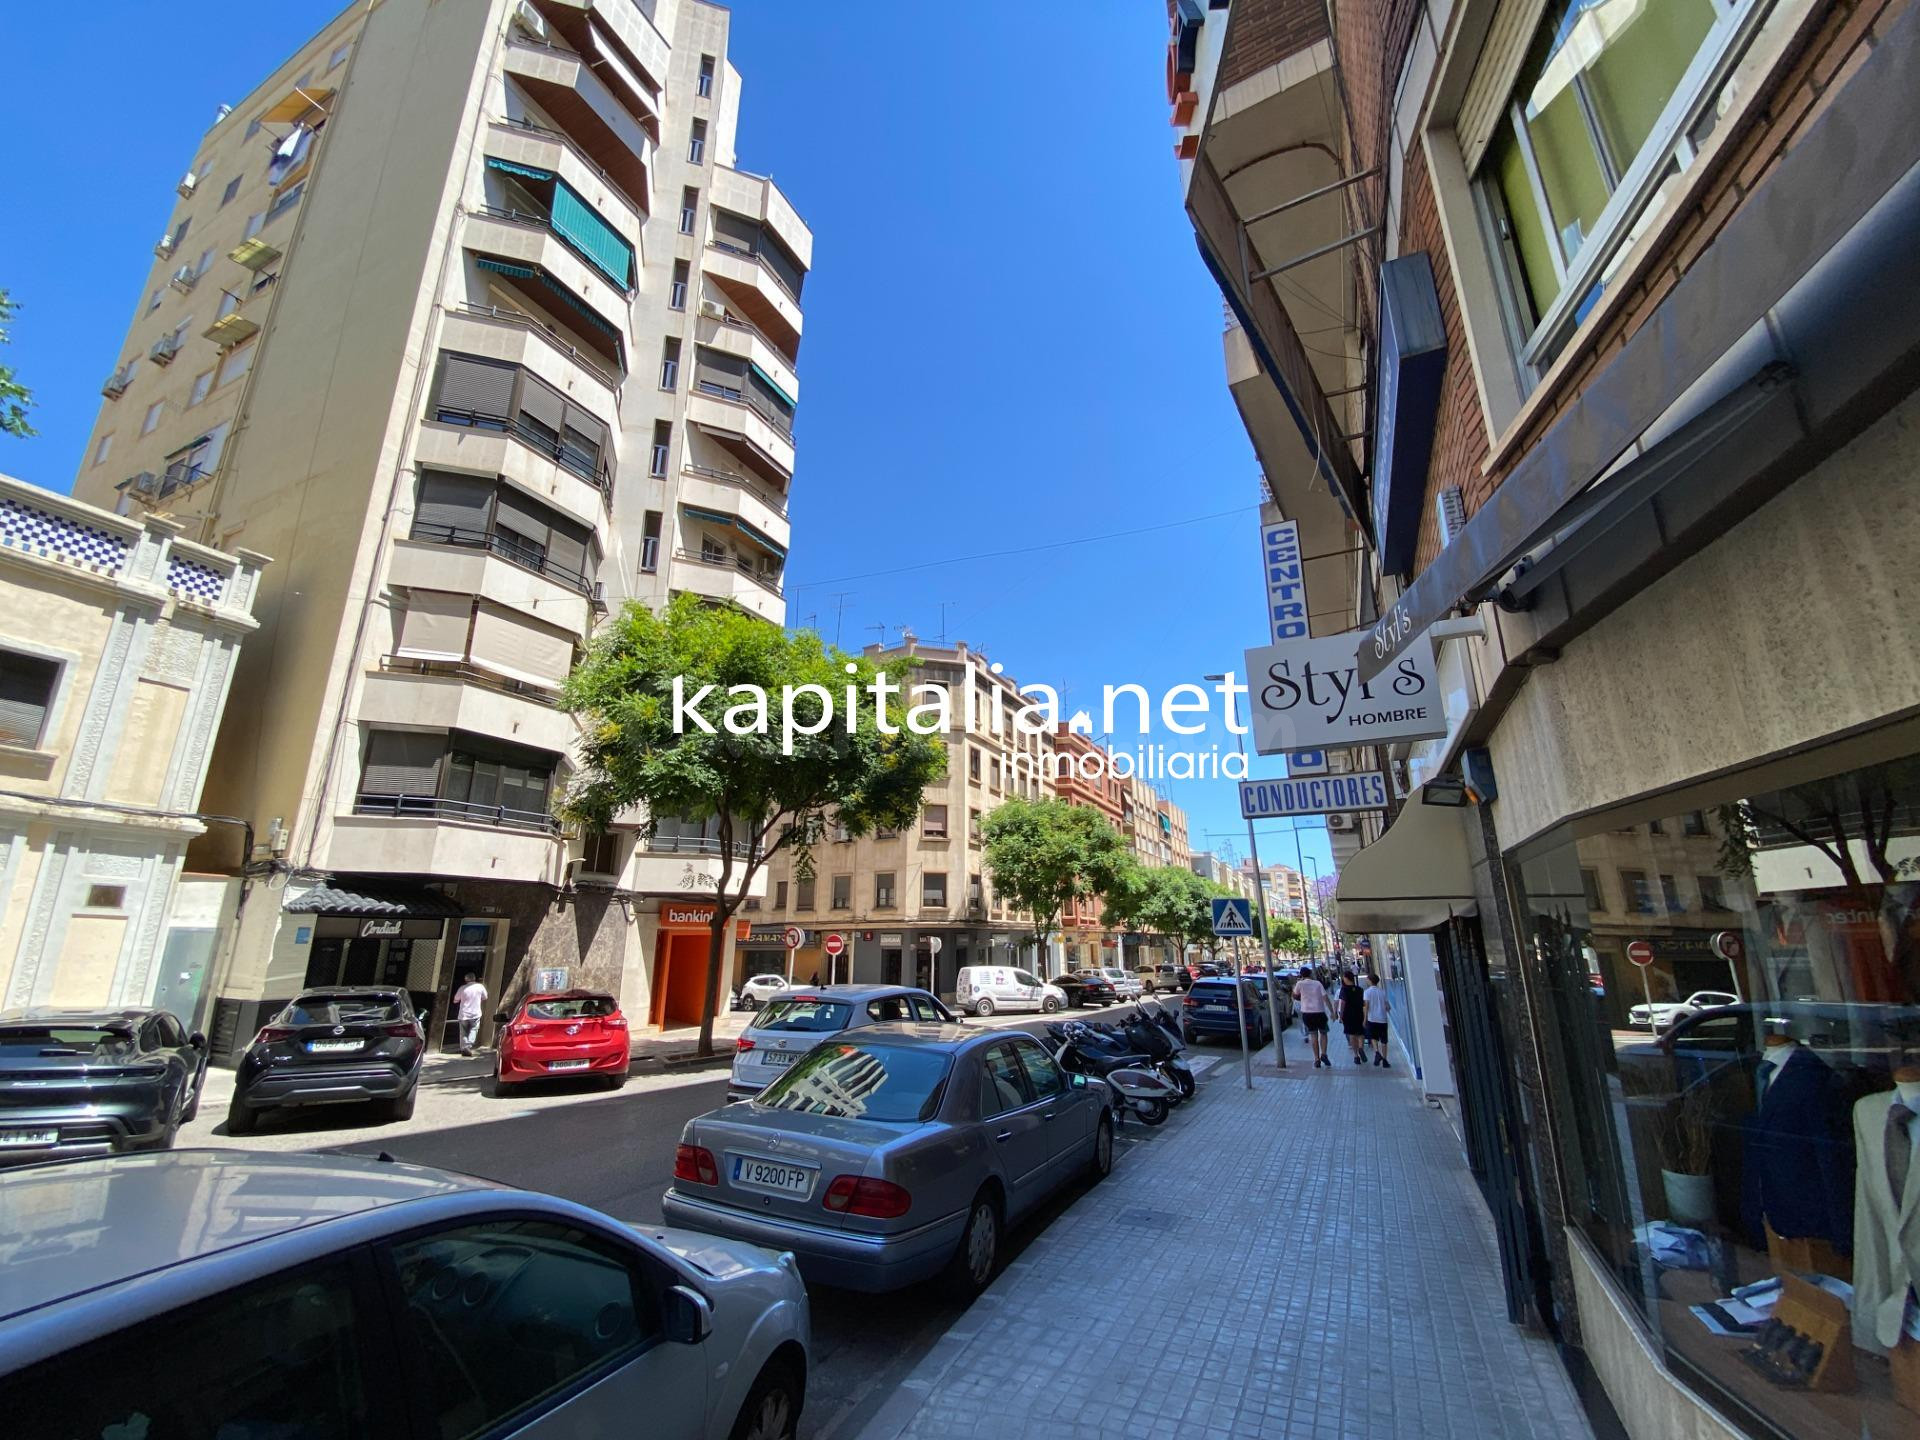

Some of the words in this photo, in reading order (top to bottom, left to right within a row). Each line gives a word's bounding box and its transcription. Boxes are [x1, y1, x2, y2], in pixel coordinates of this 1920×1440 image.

[1266, 528, 1306, 639] CENTRO
[1374, 604, 1412, 659] Styl's
[1260, 653, 1426, 724] Stys
[1349, 707, 1428, 726] HOMBRE
[1243, 776, 1384, 814] CONDUCTORES
[669, 908, 714, 923] bankin
[767, 1052, 787, 1063] 5733
[746, 1162, 754, 1180] V
[754, 1165, 786, 1186] 9200
[787, 1170, 805, 1189] FP
